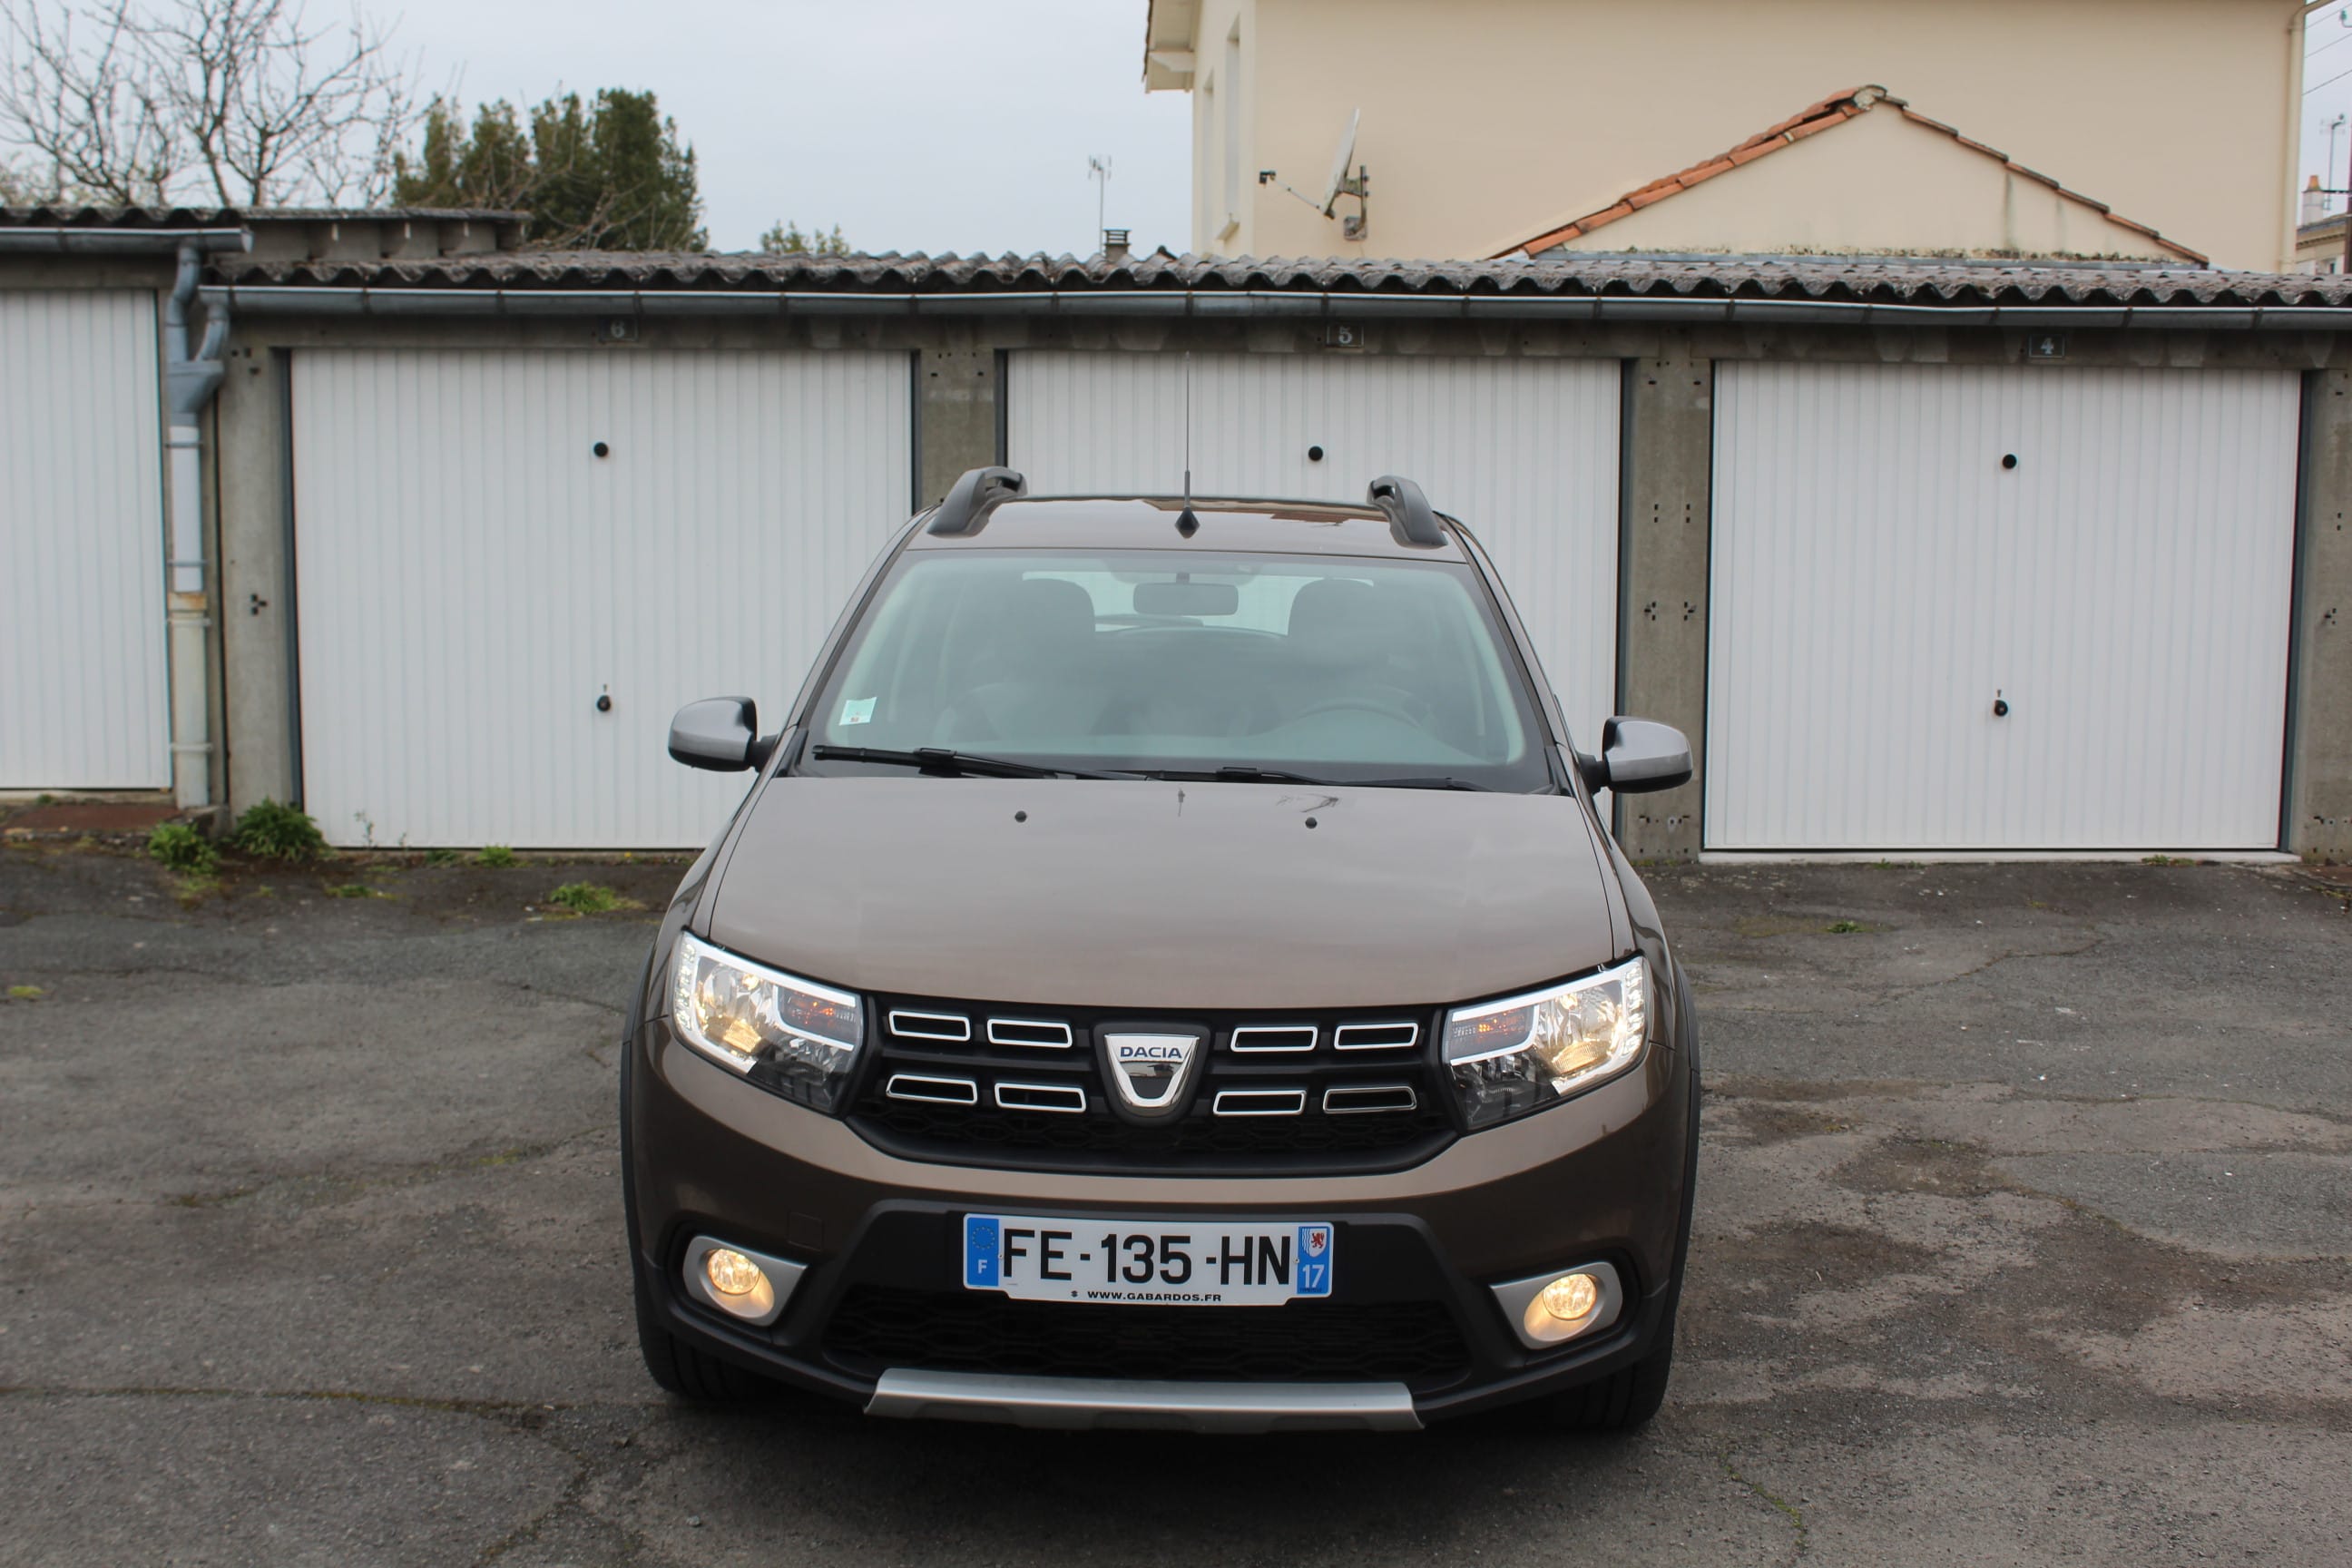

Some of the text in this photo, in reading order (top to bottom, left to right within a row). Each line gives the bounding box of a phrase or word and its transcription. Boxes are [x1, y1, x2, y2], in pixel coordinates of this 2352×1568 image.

[611, 320, 625, 338] 6
[1338, 326, 1353, 344] 5
[2040, 337, 2055, 355] 4
[1120, 1046, 1182, 1059] DACIA
[1003, 1228, 1291, 1286] FE-135-HN
[977, 1259, 988, 1274] F
[1302, 1264, 1325, 1289] 17
[1087, 1290, 1221, 1302] WWW.GABARDOS.FR
